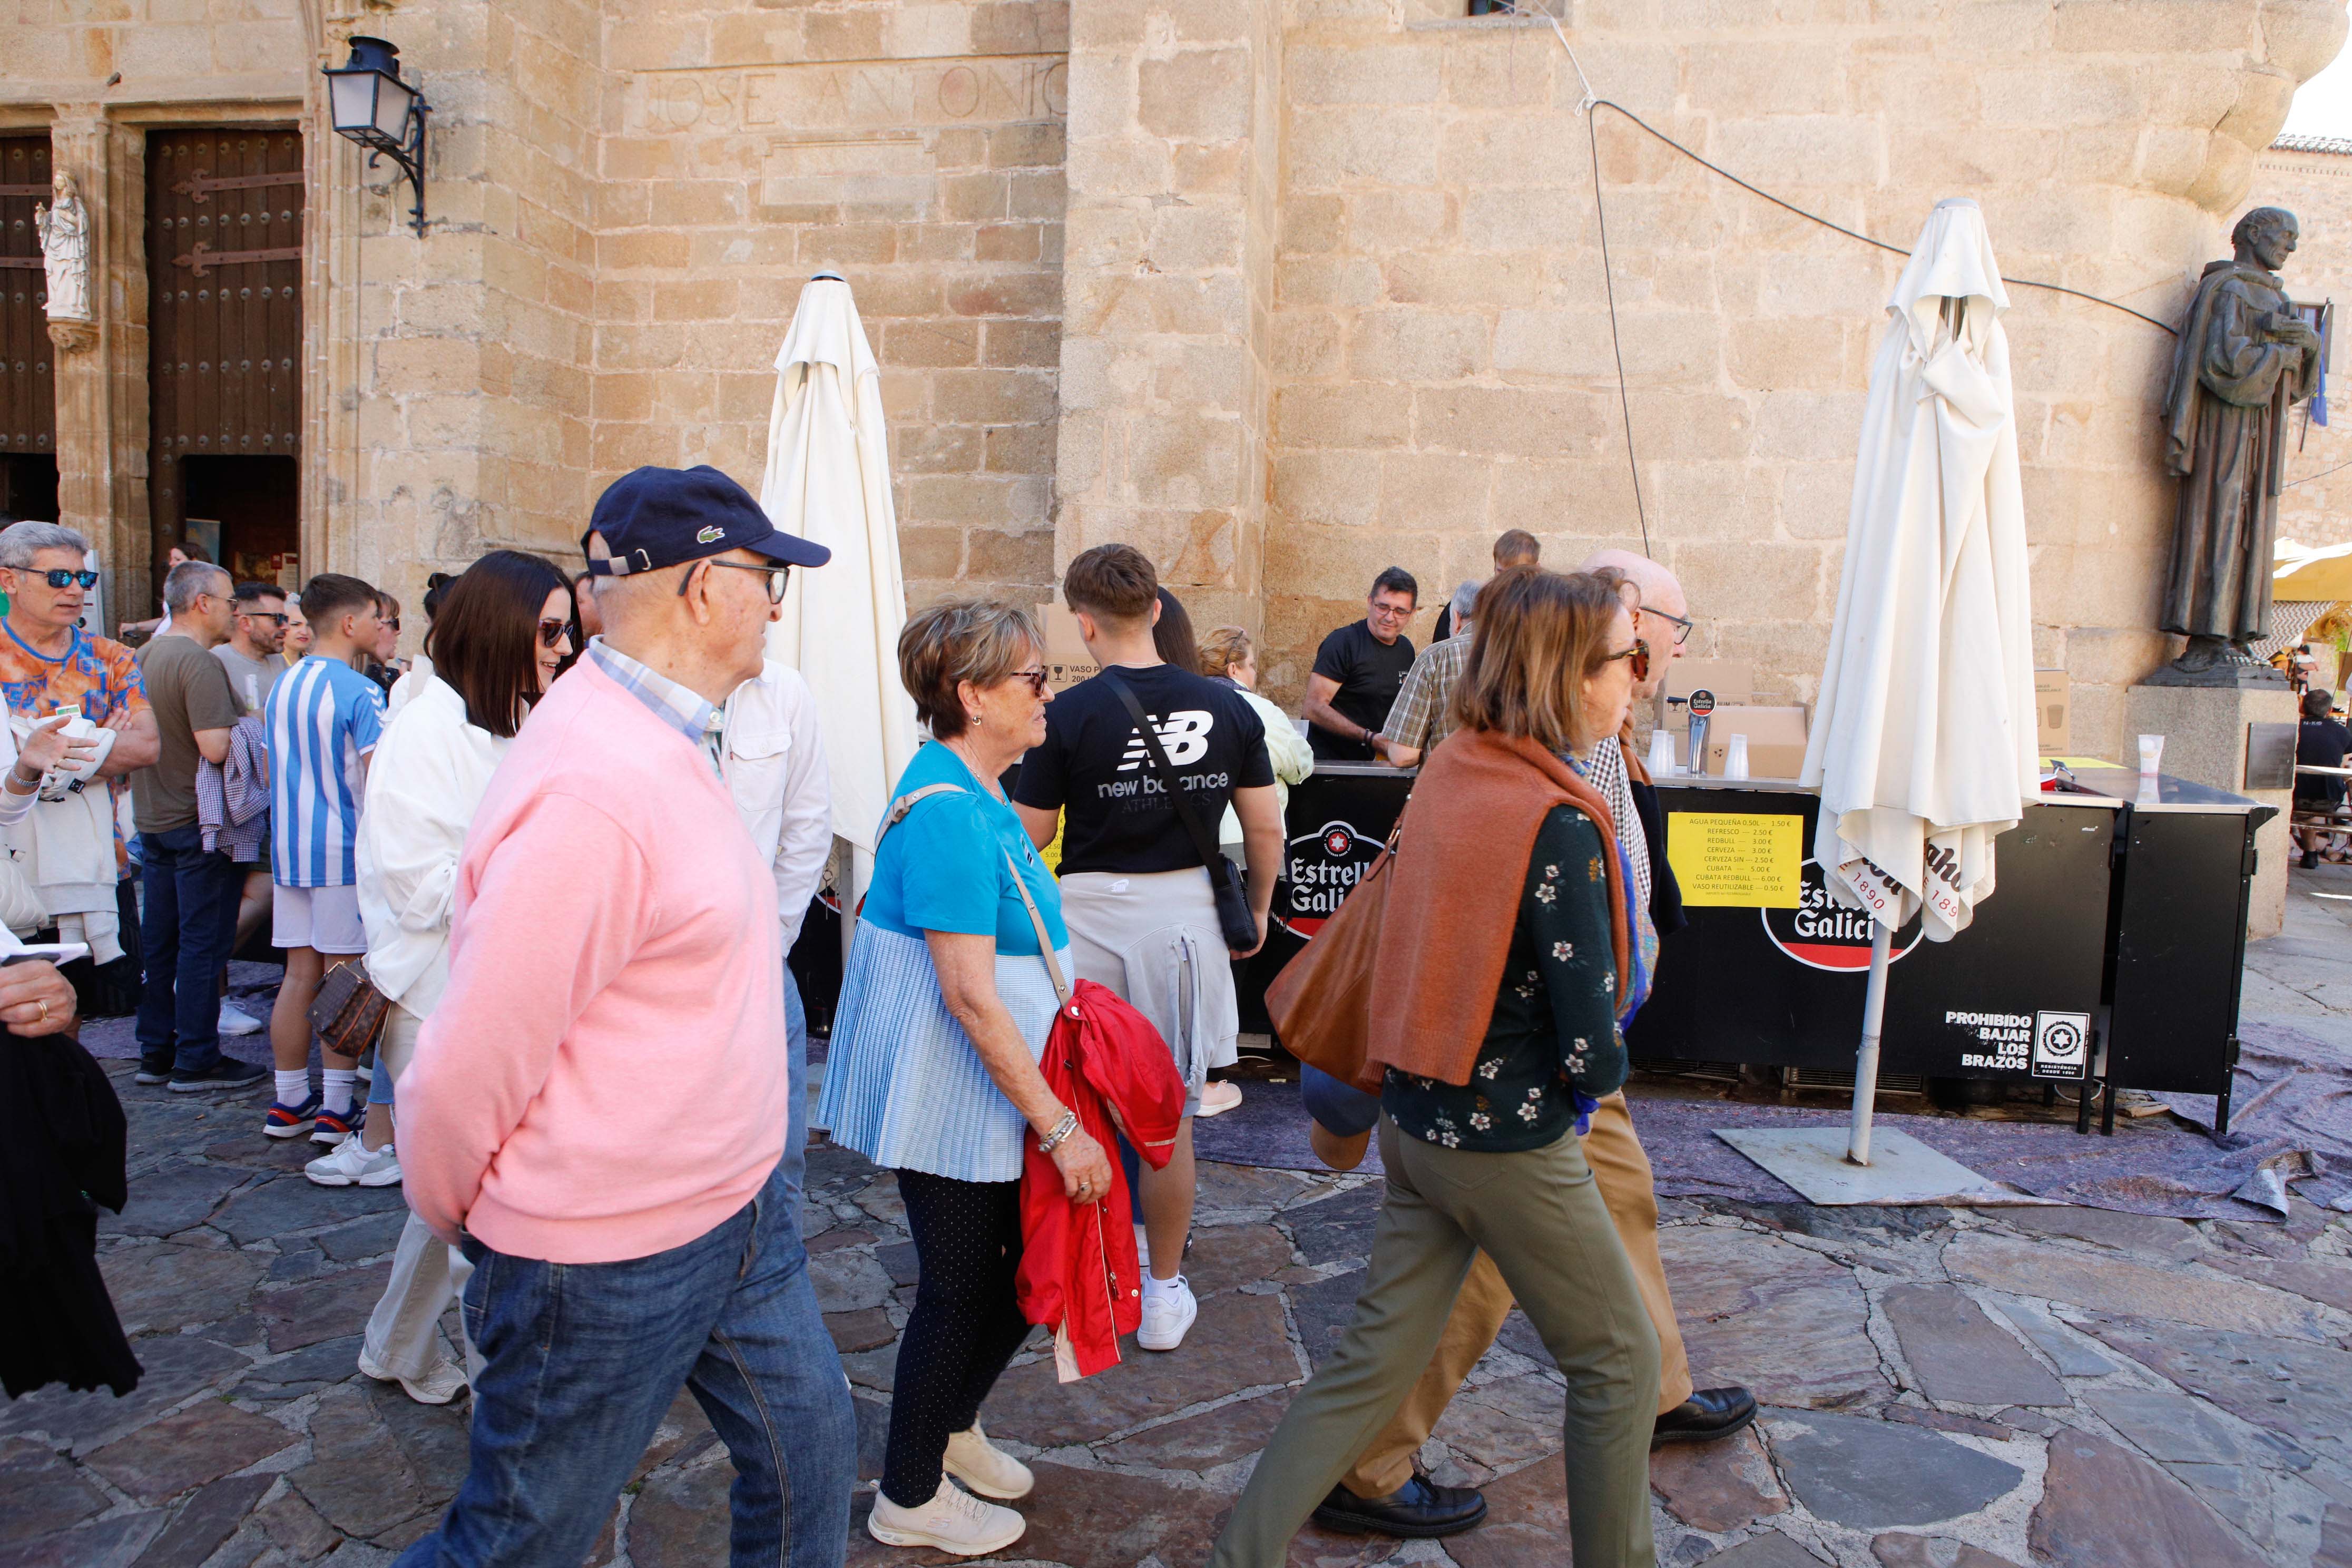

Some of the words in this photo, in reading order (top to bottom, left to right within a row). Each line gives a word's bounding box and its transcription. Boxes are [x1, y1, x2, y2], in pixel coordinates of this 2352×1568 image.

[1097, 780, 1139, 798] new
[1143, 772, 1229, 795] baance
[1122, 792, 1211, 814] ATHLECS
[1291, 857, 1369, 886] Estrel
[1924, 838, 1961, 893] aho
[1292, 885, 1344, 913] Gali
[1853, 873, 1885, 910] 1890
[1932, 890, 1957, 917] 189
[1795, 909, 1874, 940] Galici
[1945, 1011, 2032, 1028] PROHIBIDO
[1979, 1027, 2031, 1042] BAJAR
[1998, 1042, 2029, 1055] LOS
[1962, 1054, 2027, 1070] BRAZOS
